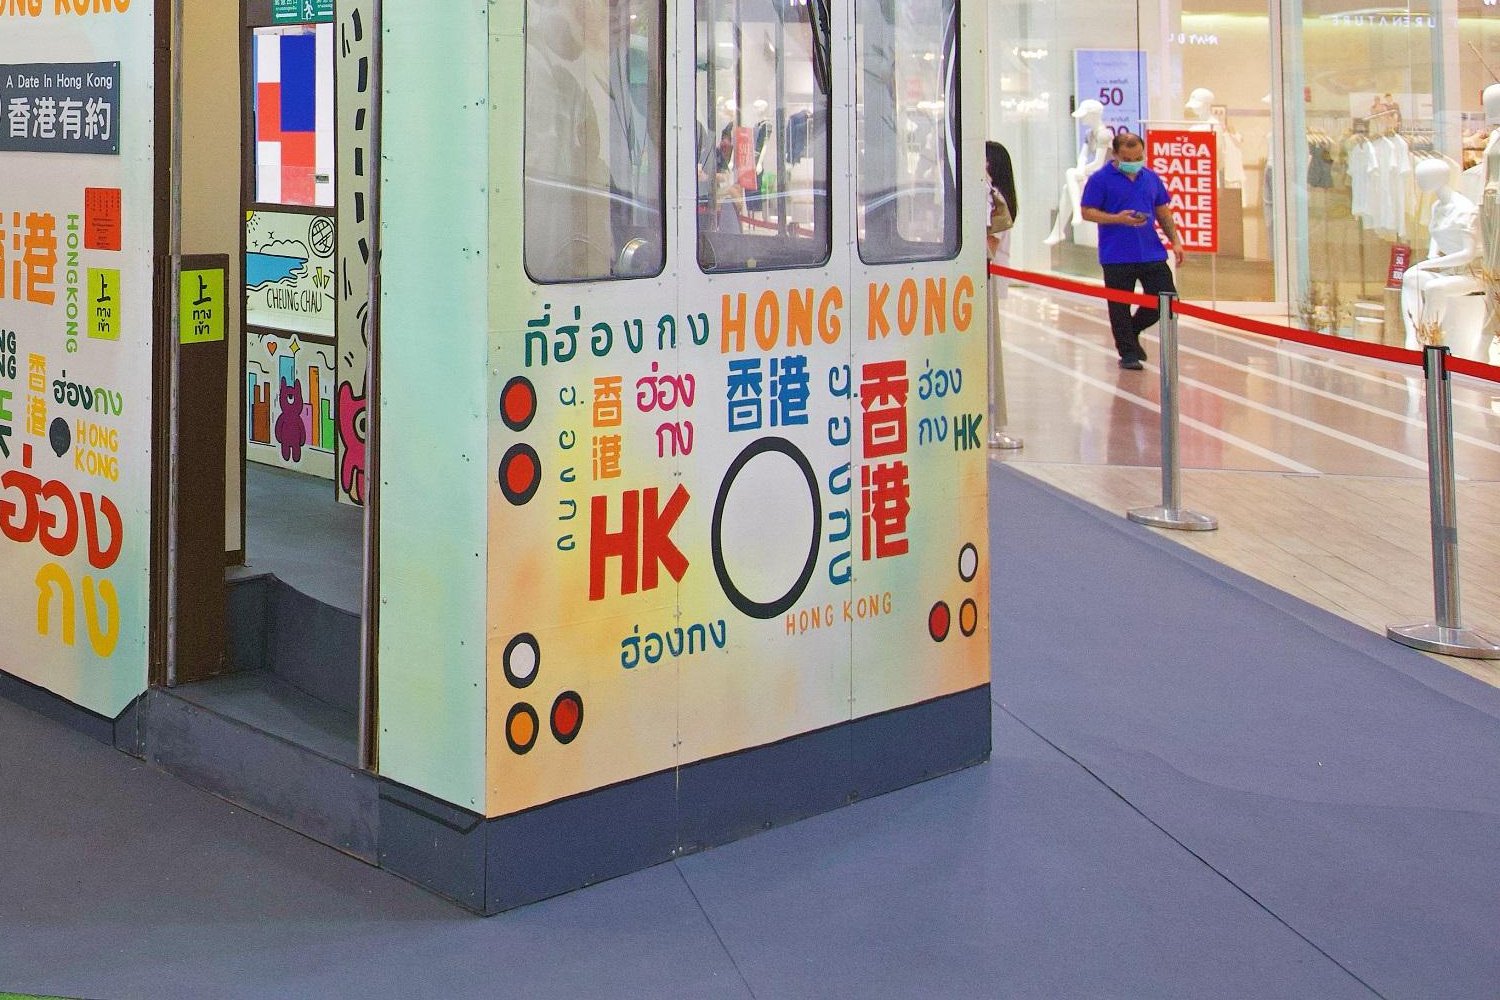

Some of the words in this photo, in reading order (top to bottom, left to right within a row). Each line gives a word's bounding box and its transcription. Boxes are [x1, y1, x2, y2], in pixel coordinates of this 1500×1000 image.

[6, 75, 13, 89] A
[18, 74, 40, 88] Date
[43, 74, 52, 88] In
[56, 74, 82, 90] Hong
[86, 73, 113, 90] Kong
[8, 96, 111, 141] 香港有約
[1153, 142, 1211, 157] MEGA
[1153, 158, 1211, 175] SALE
[1167, 195, 1211, 211] ALE
[1172, 213, 1211, 229] ALE
[97, 274, 111, 303] 上
[192, 274, 212, 306] 上
[267, 288, 299, 313] CHEUNG
[300, 289, 323, 313] CHAU
[721, 286, 843, 354] HONG
[867, 275, 974, 342] KONG
[26, 353, 47, 438] 香港
[52, 369, 123, 417] ฮ่องกง
[636, 361, 695, 413] ฮ่อง
[726, 354, 810, 433] 香港
[918, 358, 962, 401] ฮ่อง
[76, 418, 118, 453] HONG
[592, 375, 623, 481] 香港
[656, 420, 694, 459] กง
[918, 416, 948, 446] กง
[953, 413, 983, 452] HK
[75, 445, 119, 482] KONG
[860, 359, 910, 562] 香港
[0, 443, 123, 570] ฮ่อง
[589, 482, 690, 602] HK
[35, 562, 120, 658] กง
[786, 606, 834, 636] HONG
[843, 591, 892, 622] KONG
[621, 619, 727, 669] ฮ่องกง
